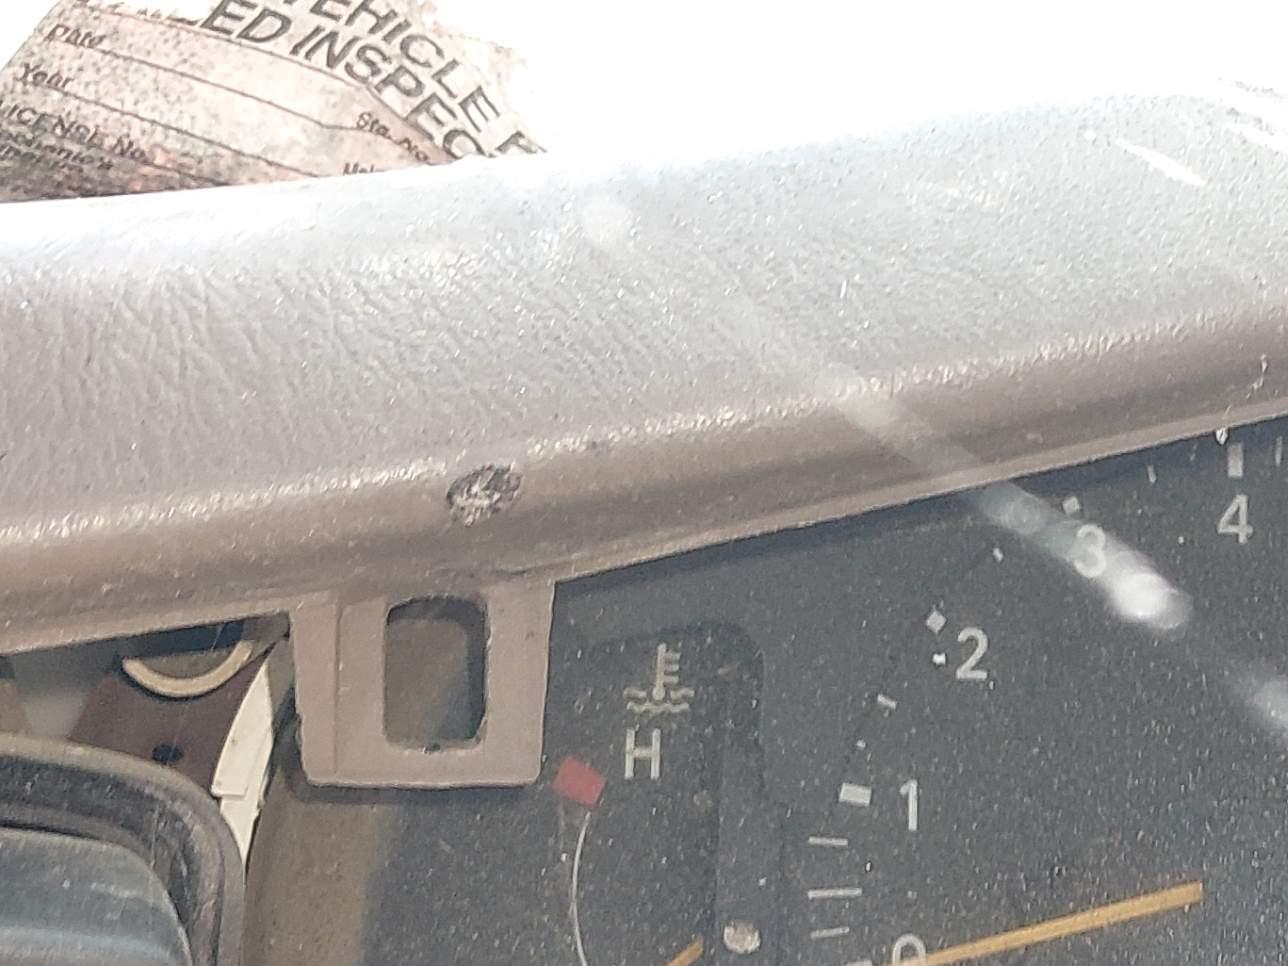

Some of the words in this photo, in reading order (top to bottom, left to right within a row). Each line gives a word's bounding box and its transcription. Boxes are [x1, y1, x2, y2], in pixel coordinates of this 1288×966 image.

[283, 0, 500, 132] EHICLE
[1217, 494, 1254, 544] 4
[1073, 523, 1106, 578] 3
[956, 627, 989, 680] 2
[624, 728, 661, 780] H
[900, 779, 919, 832] 1
